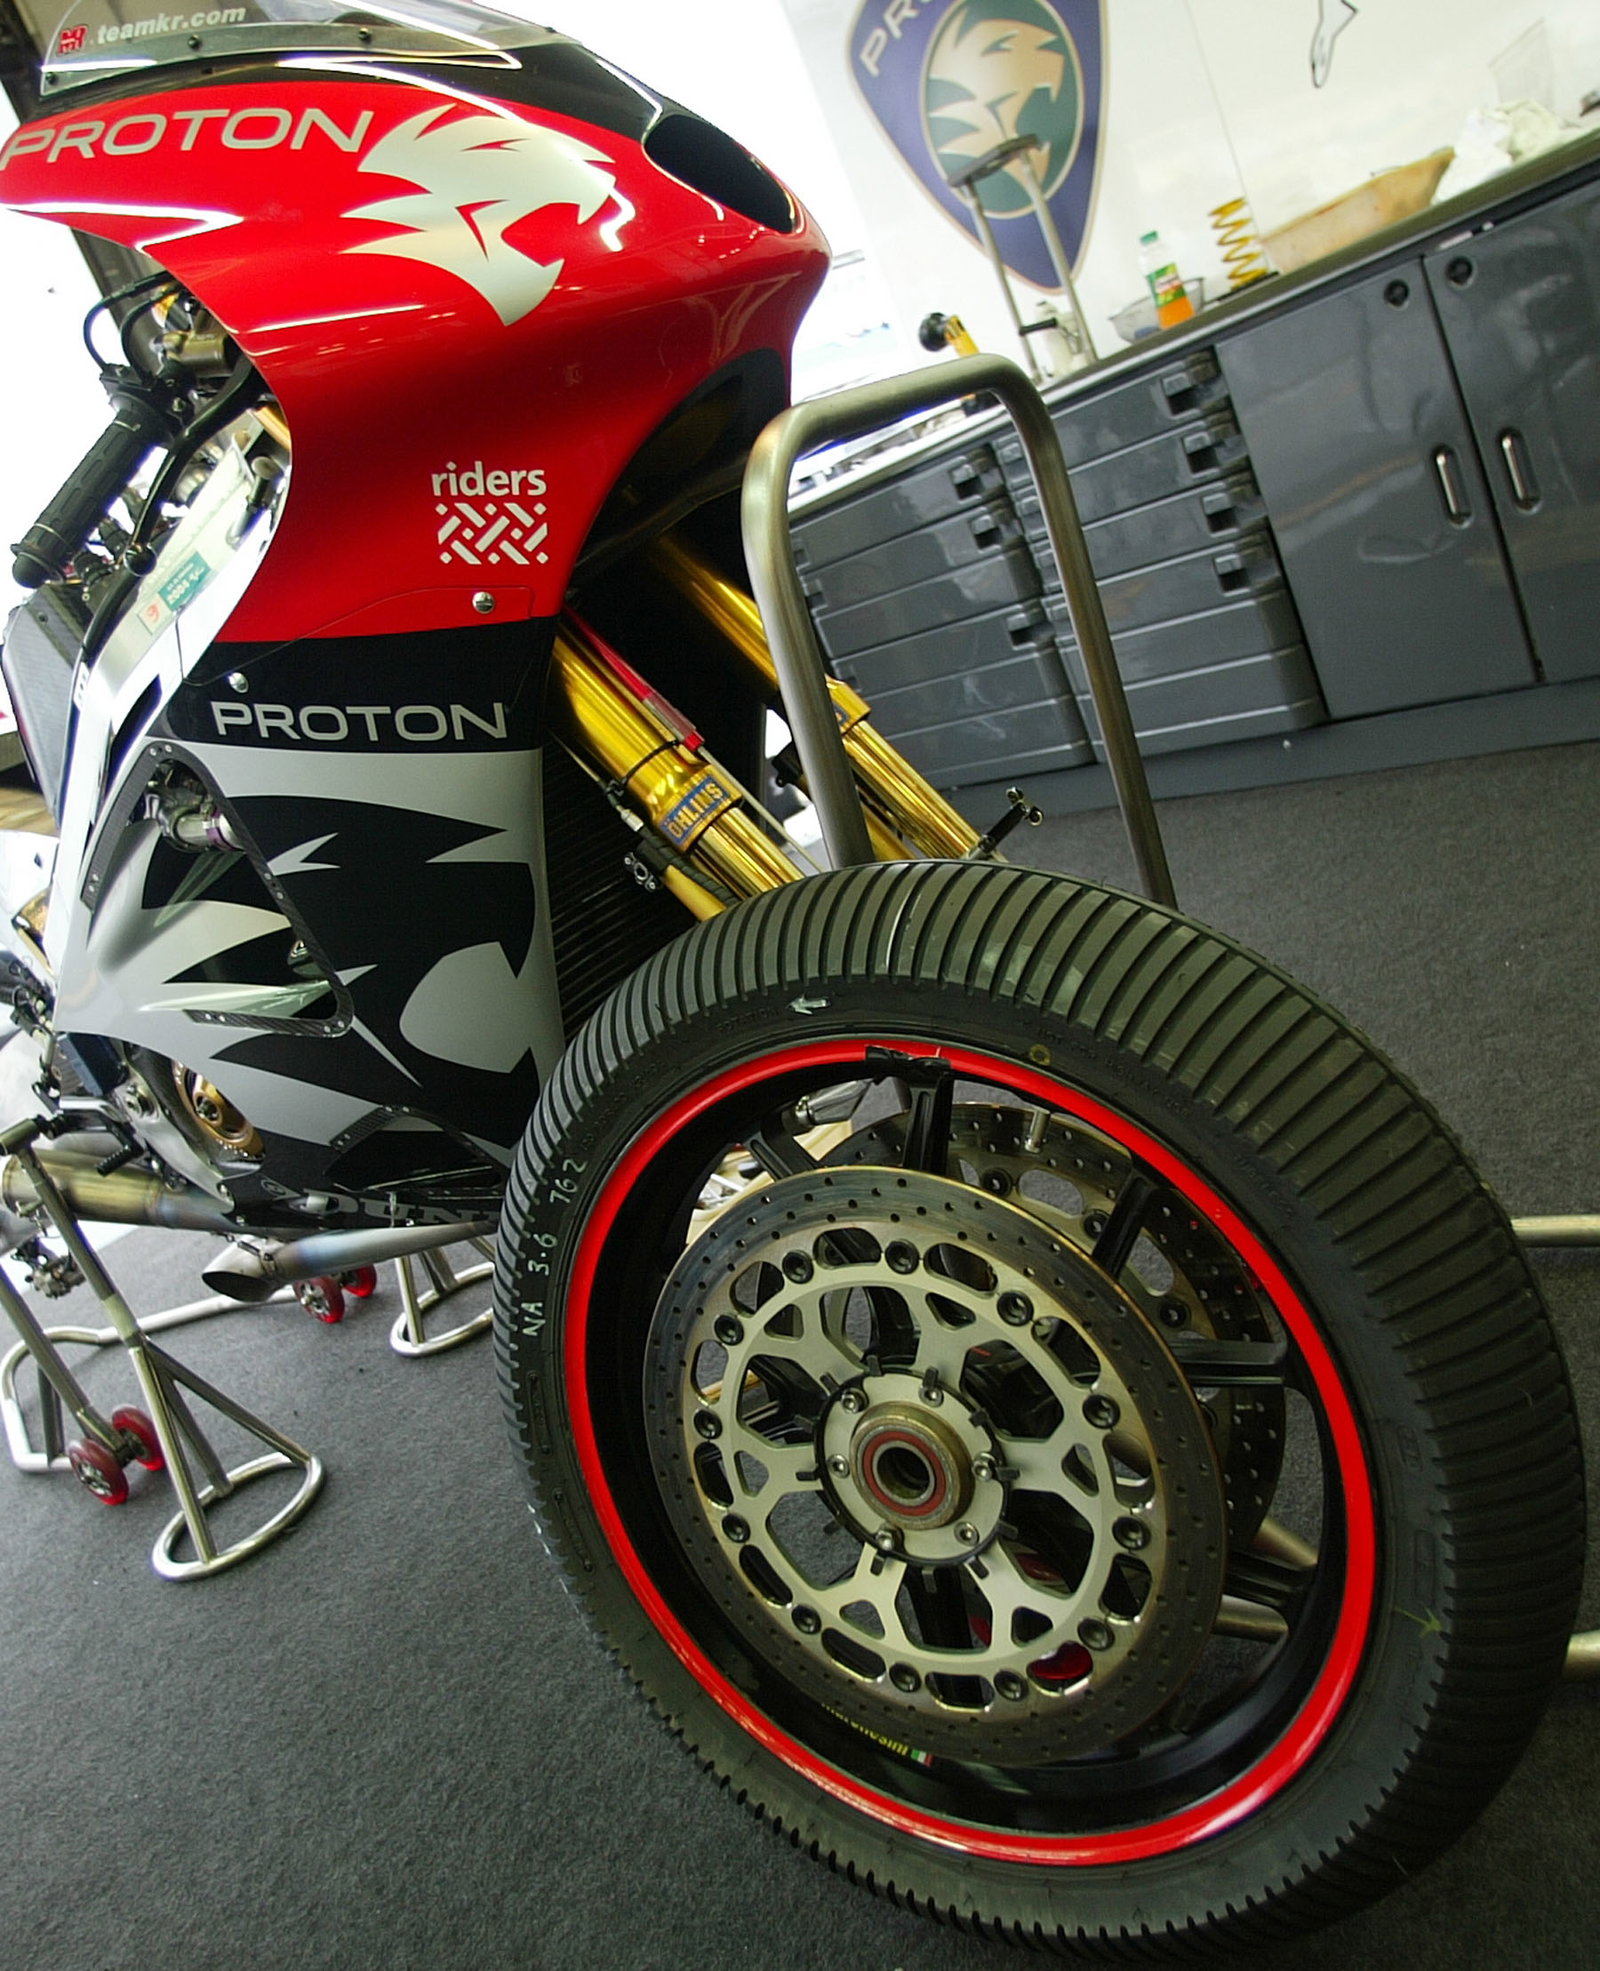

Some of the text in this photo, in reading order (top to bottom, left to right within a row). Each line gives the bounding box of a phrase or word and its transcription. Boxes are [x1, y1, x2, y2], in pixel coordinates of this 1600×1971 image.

[97, 7, 246, 45] teamkr.com
[859, 0, 936, 77] PR
[0, 108, 374, 171] PROTON
[431, 460, 547, 497] riders
[210, 701, 507, 742] PROTON
[528, 1233, 558, 1276] 3.6
[521, 1302, 546, 1337] NA
